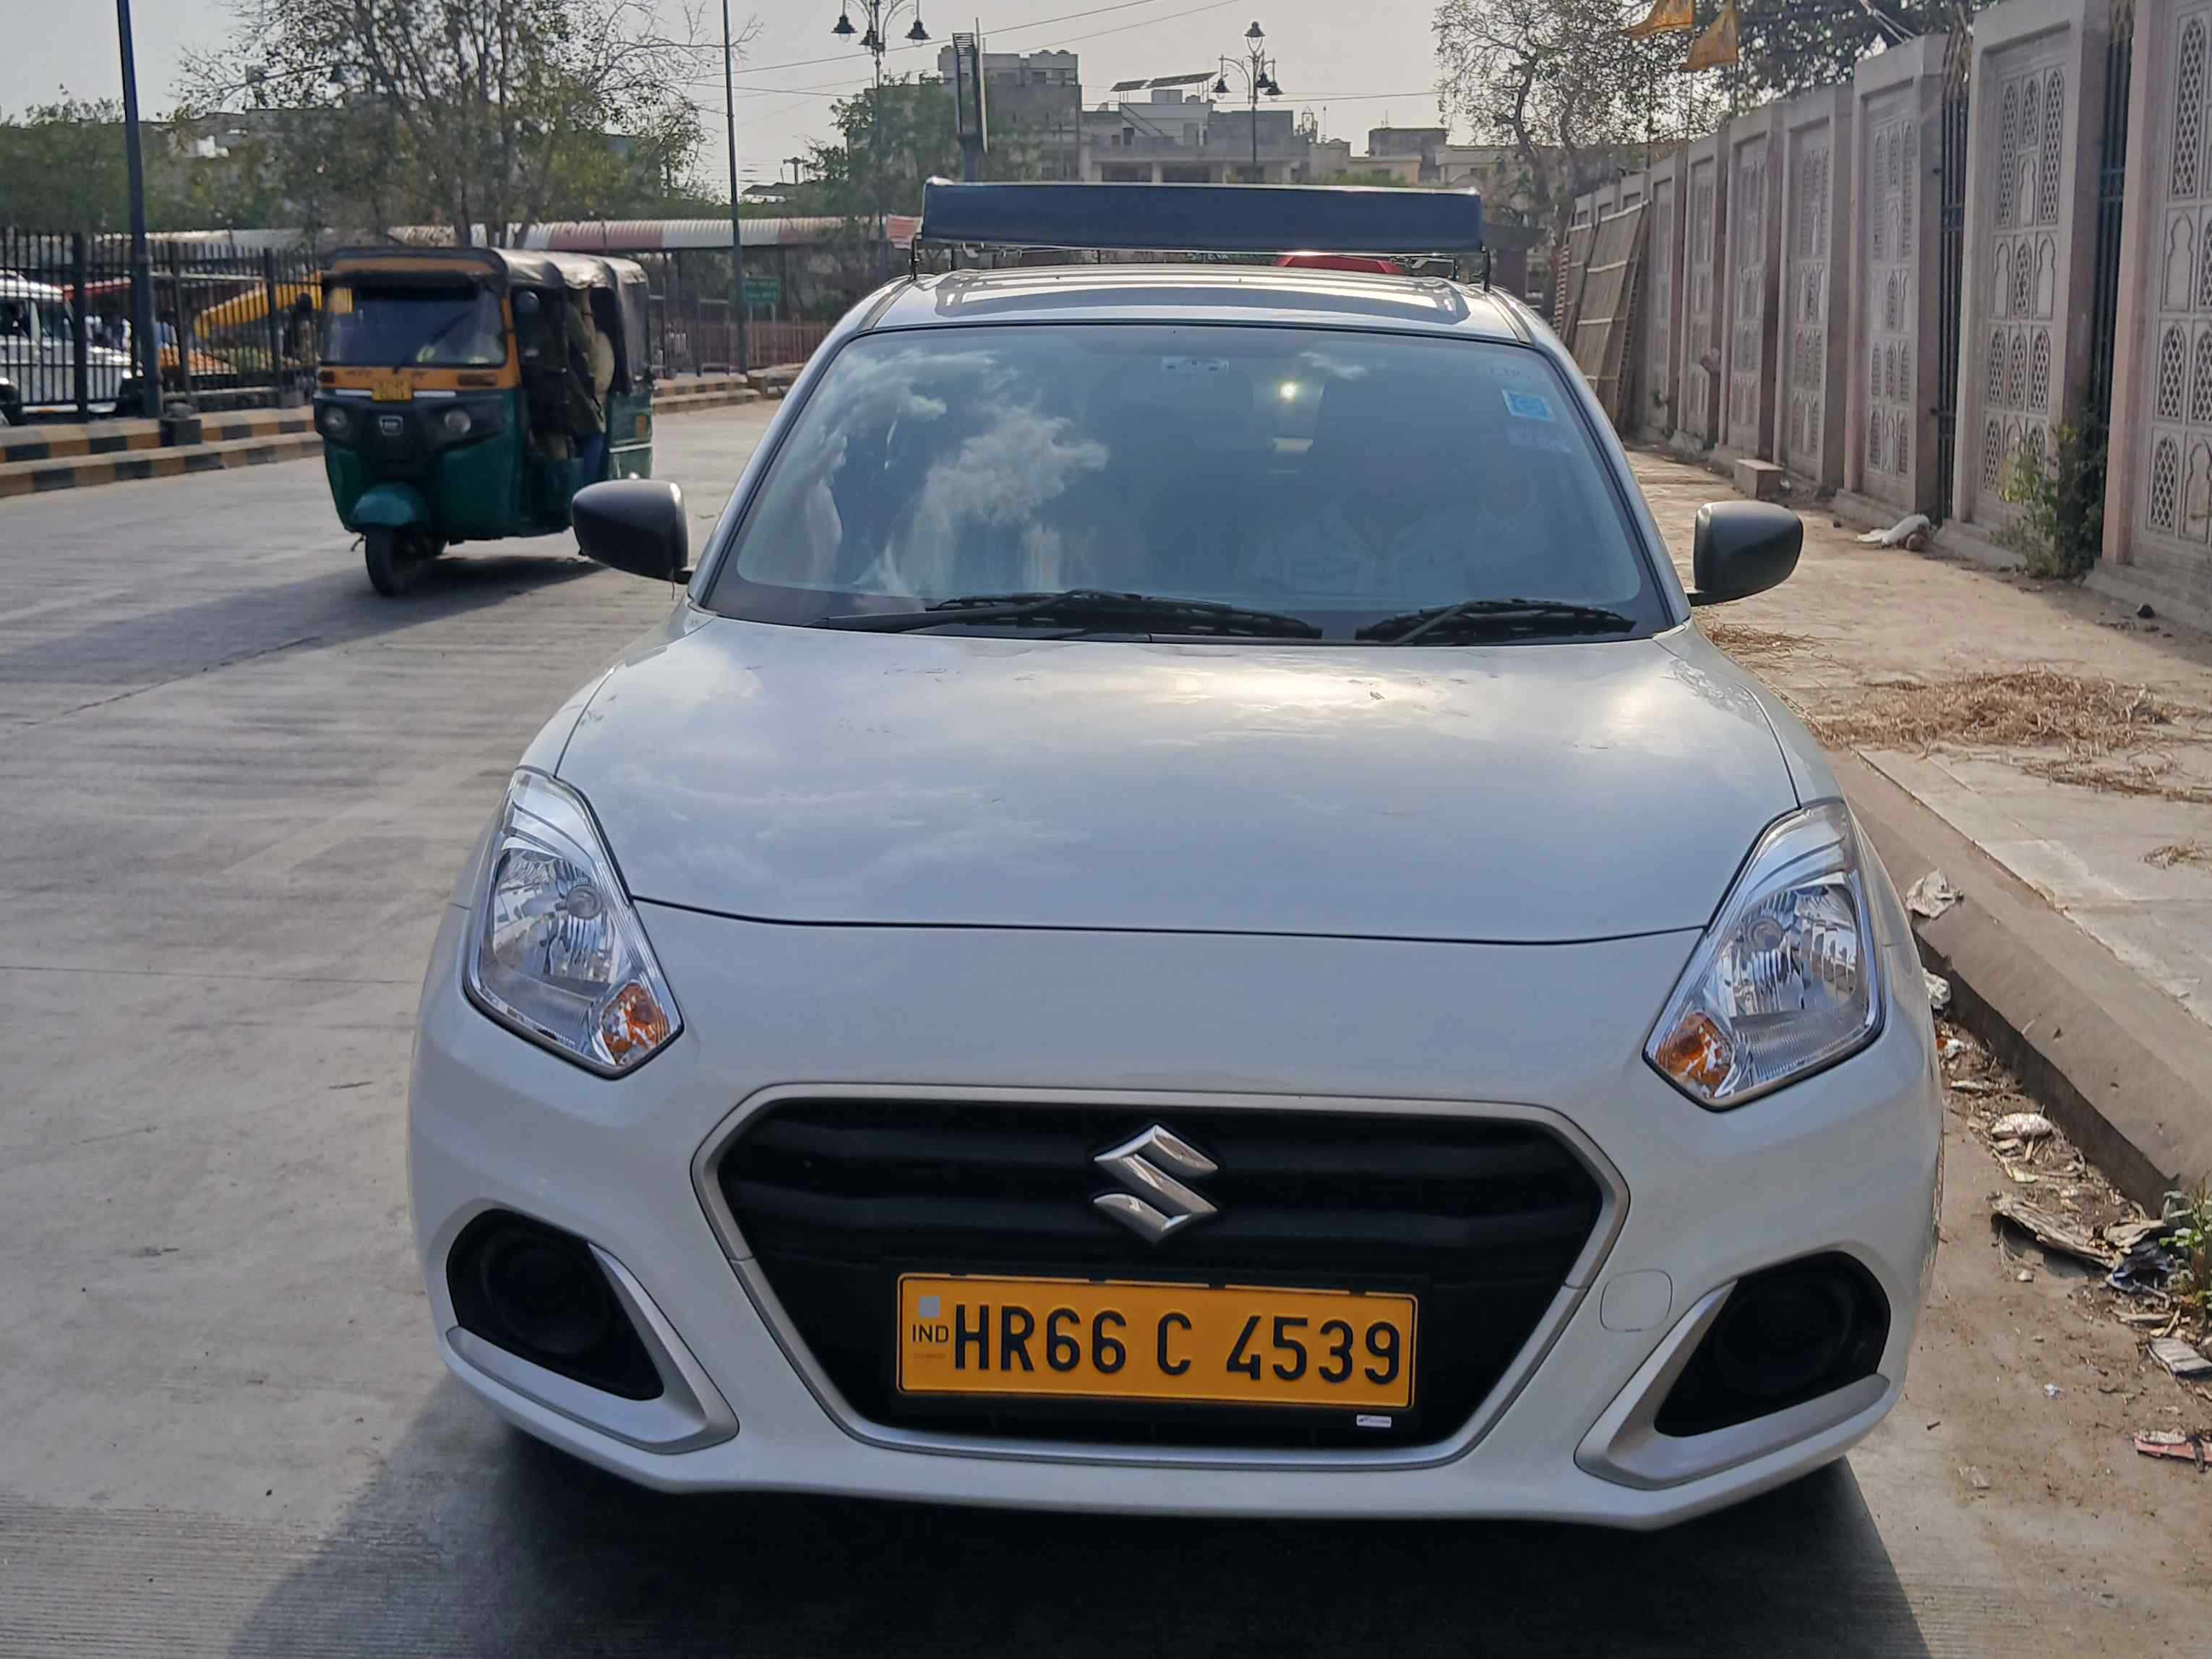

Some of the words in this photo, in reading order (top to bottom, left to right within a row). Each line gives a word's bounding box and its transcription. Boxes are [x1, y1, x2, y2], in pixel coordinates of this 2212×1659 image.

[912, 1324, 949, 1343] IND
[954, 1304, 1127, 1375] HR66
[1157, 1313, 1193, 1376] C
[1225, 1316, 1401, 1386] 4539
